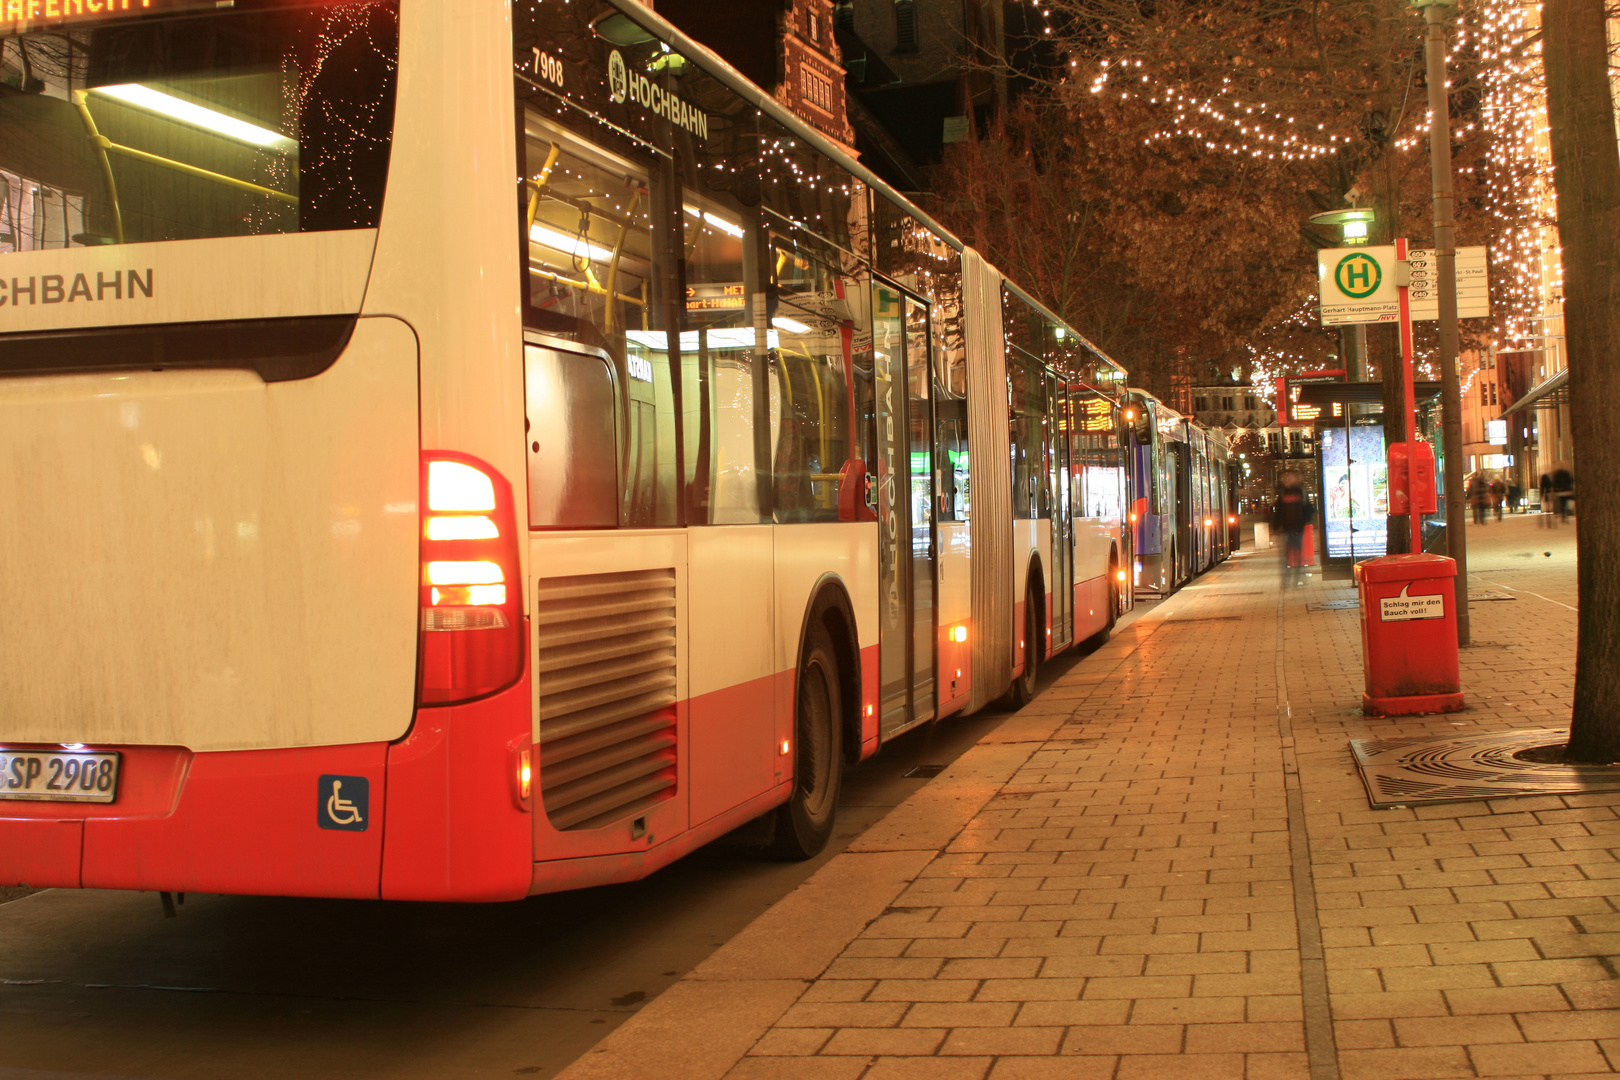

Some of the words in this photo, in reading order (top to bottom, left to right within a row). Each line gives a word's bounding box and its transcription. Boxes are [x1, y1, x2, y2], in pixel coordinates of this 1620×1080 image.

[532, 46, 564, 87] 7908
[628, 69, 708, 140] HOCHBAHN
[1346, 263, 1370, 289] H
[883, 321, 897, 571] HOCHBAHN
[7, 757, 42, 789] SP
[46, 758, 114, 792] 2908
